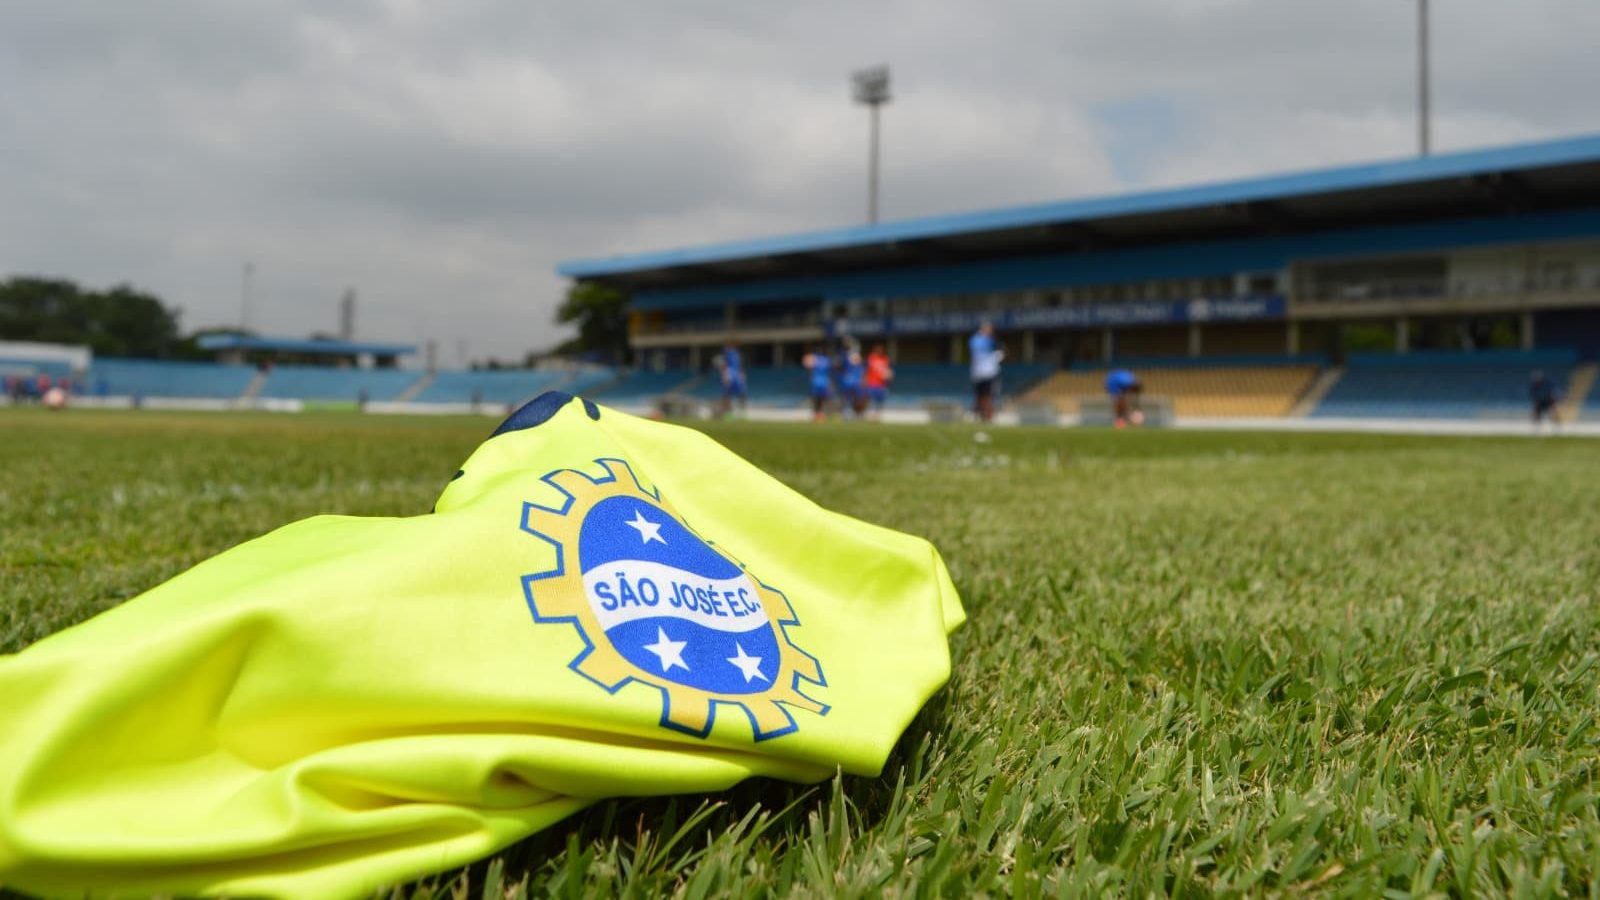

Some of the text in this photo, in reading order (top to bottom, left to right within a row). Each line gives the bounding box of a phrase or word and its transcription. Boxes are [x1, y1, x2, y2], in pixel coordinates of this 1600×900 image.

[594, 571, 761, 617] SÃO JOSÉ E.C.
